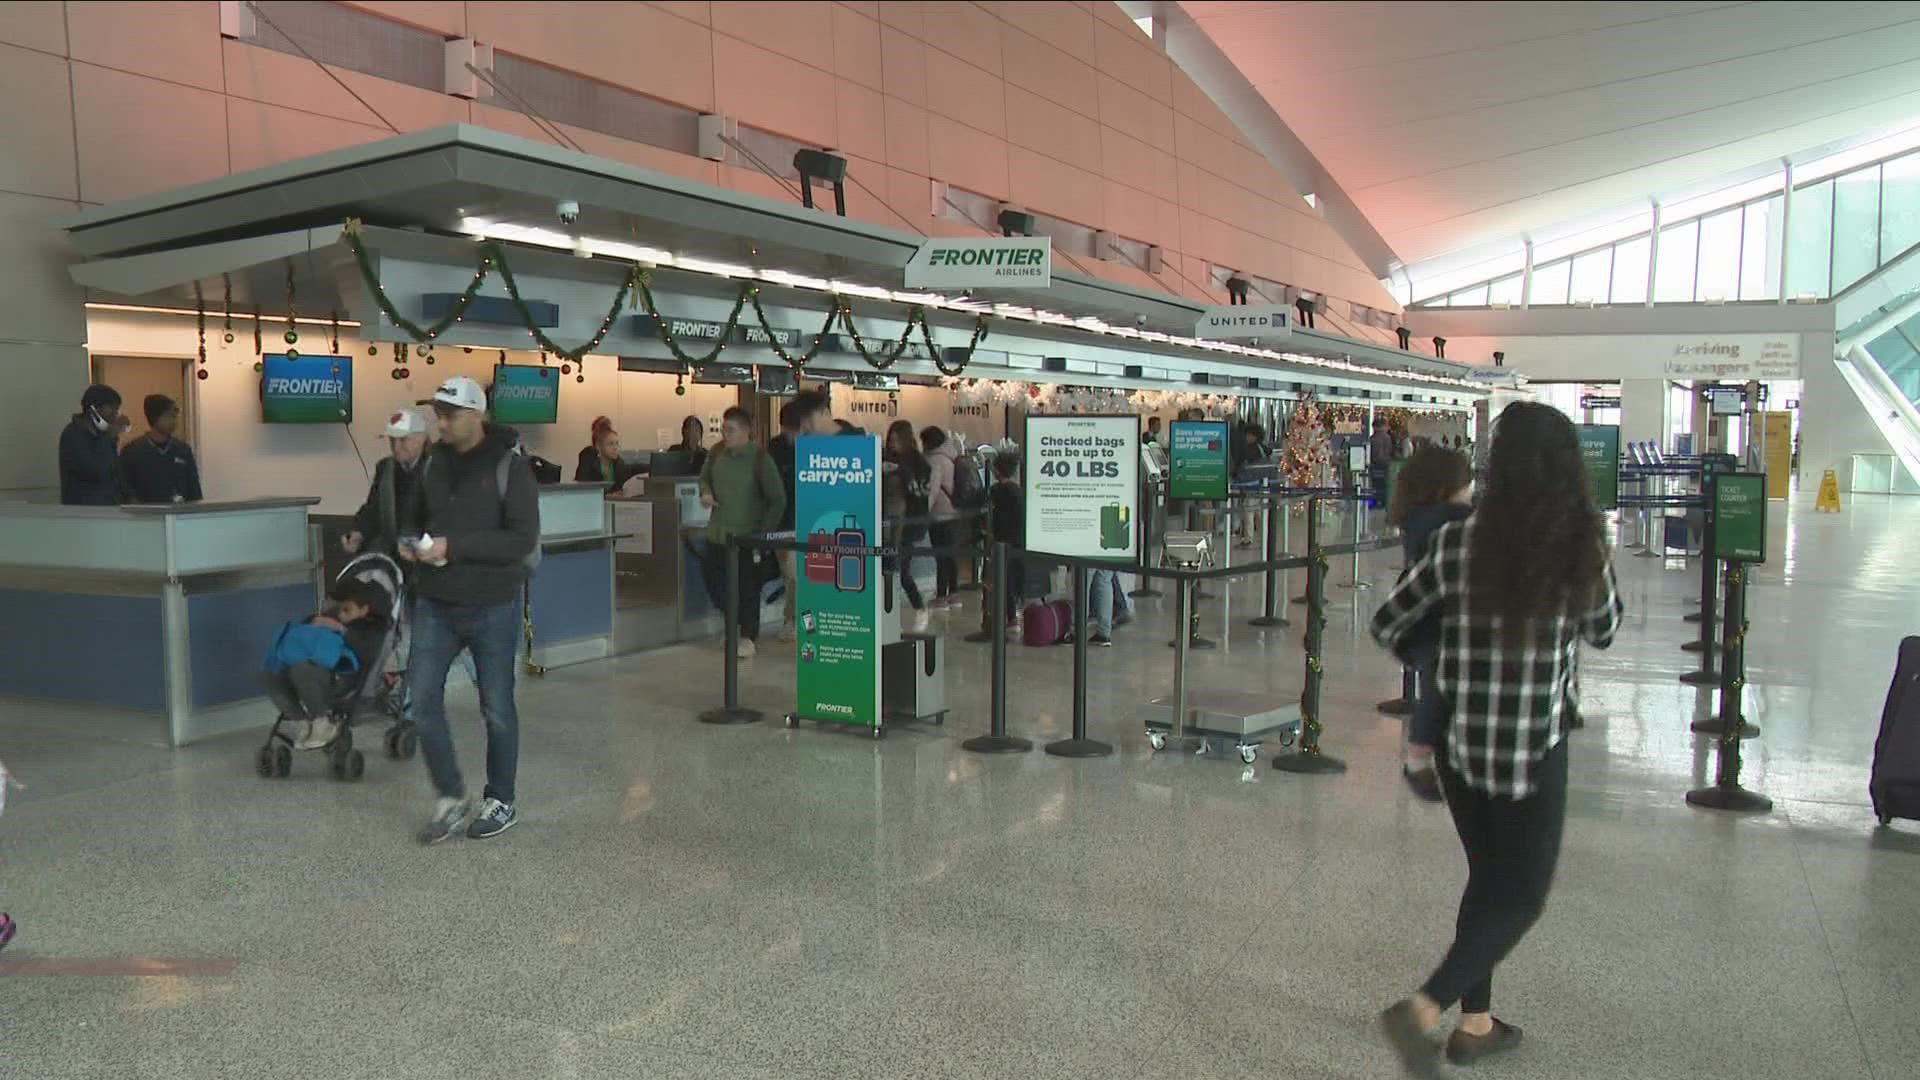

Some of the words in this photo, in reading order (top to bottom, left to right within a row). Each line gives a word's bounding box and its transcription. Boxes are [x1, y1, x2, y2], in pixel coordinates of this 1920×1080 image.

[928, 248, 1044, 266] FRONTIER
[994, 267, 1043, 277] AIRLINES
[1210, 316, 1269, 326] UNITED
[671, 321, 721, 338] FRONTIER
[267, 377, 344, 394] FRONTIER
[496, 384, 553, 400] FRONTIER
[850, 402, 887, 413] UNITED
[952, 406, 981, 416] UNITED
[1040, 436, 1092, 446] Checked
[1095, 437, 1125, 448] bags
[1040, 449, 1062, 457] can
[1064, 447, 1080, 457] be
[1083, 449, 1099, 459] up
[1102, 448, 1115, 457] to
[809, 454, 848, 469] Have
[850, 458, 861, 469] a
[1040, 461, 1071, 478] 40
[1076, 461, 1120, 478] LBS
[798, 469, 873, 485] carry-on?
[1720, 485, 1741, 494] TICKET
[1720, 494, 1748, 502] COUNTER
[820, 544, 899, 556] FLYFRONTIER.COM
[815, 702, 854, 715] FRONTIER
